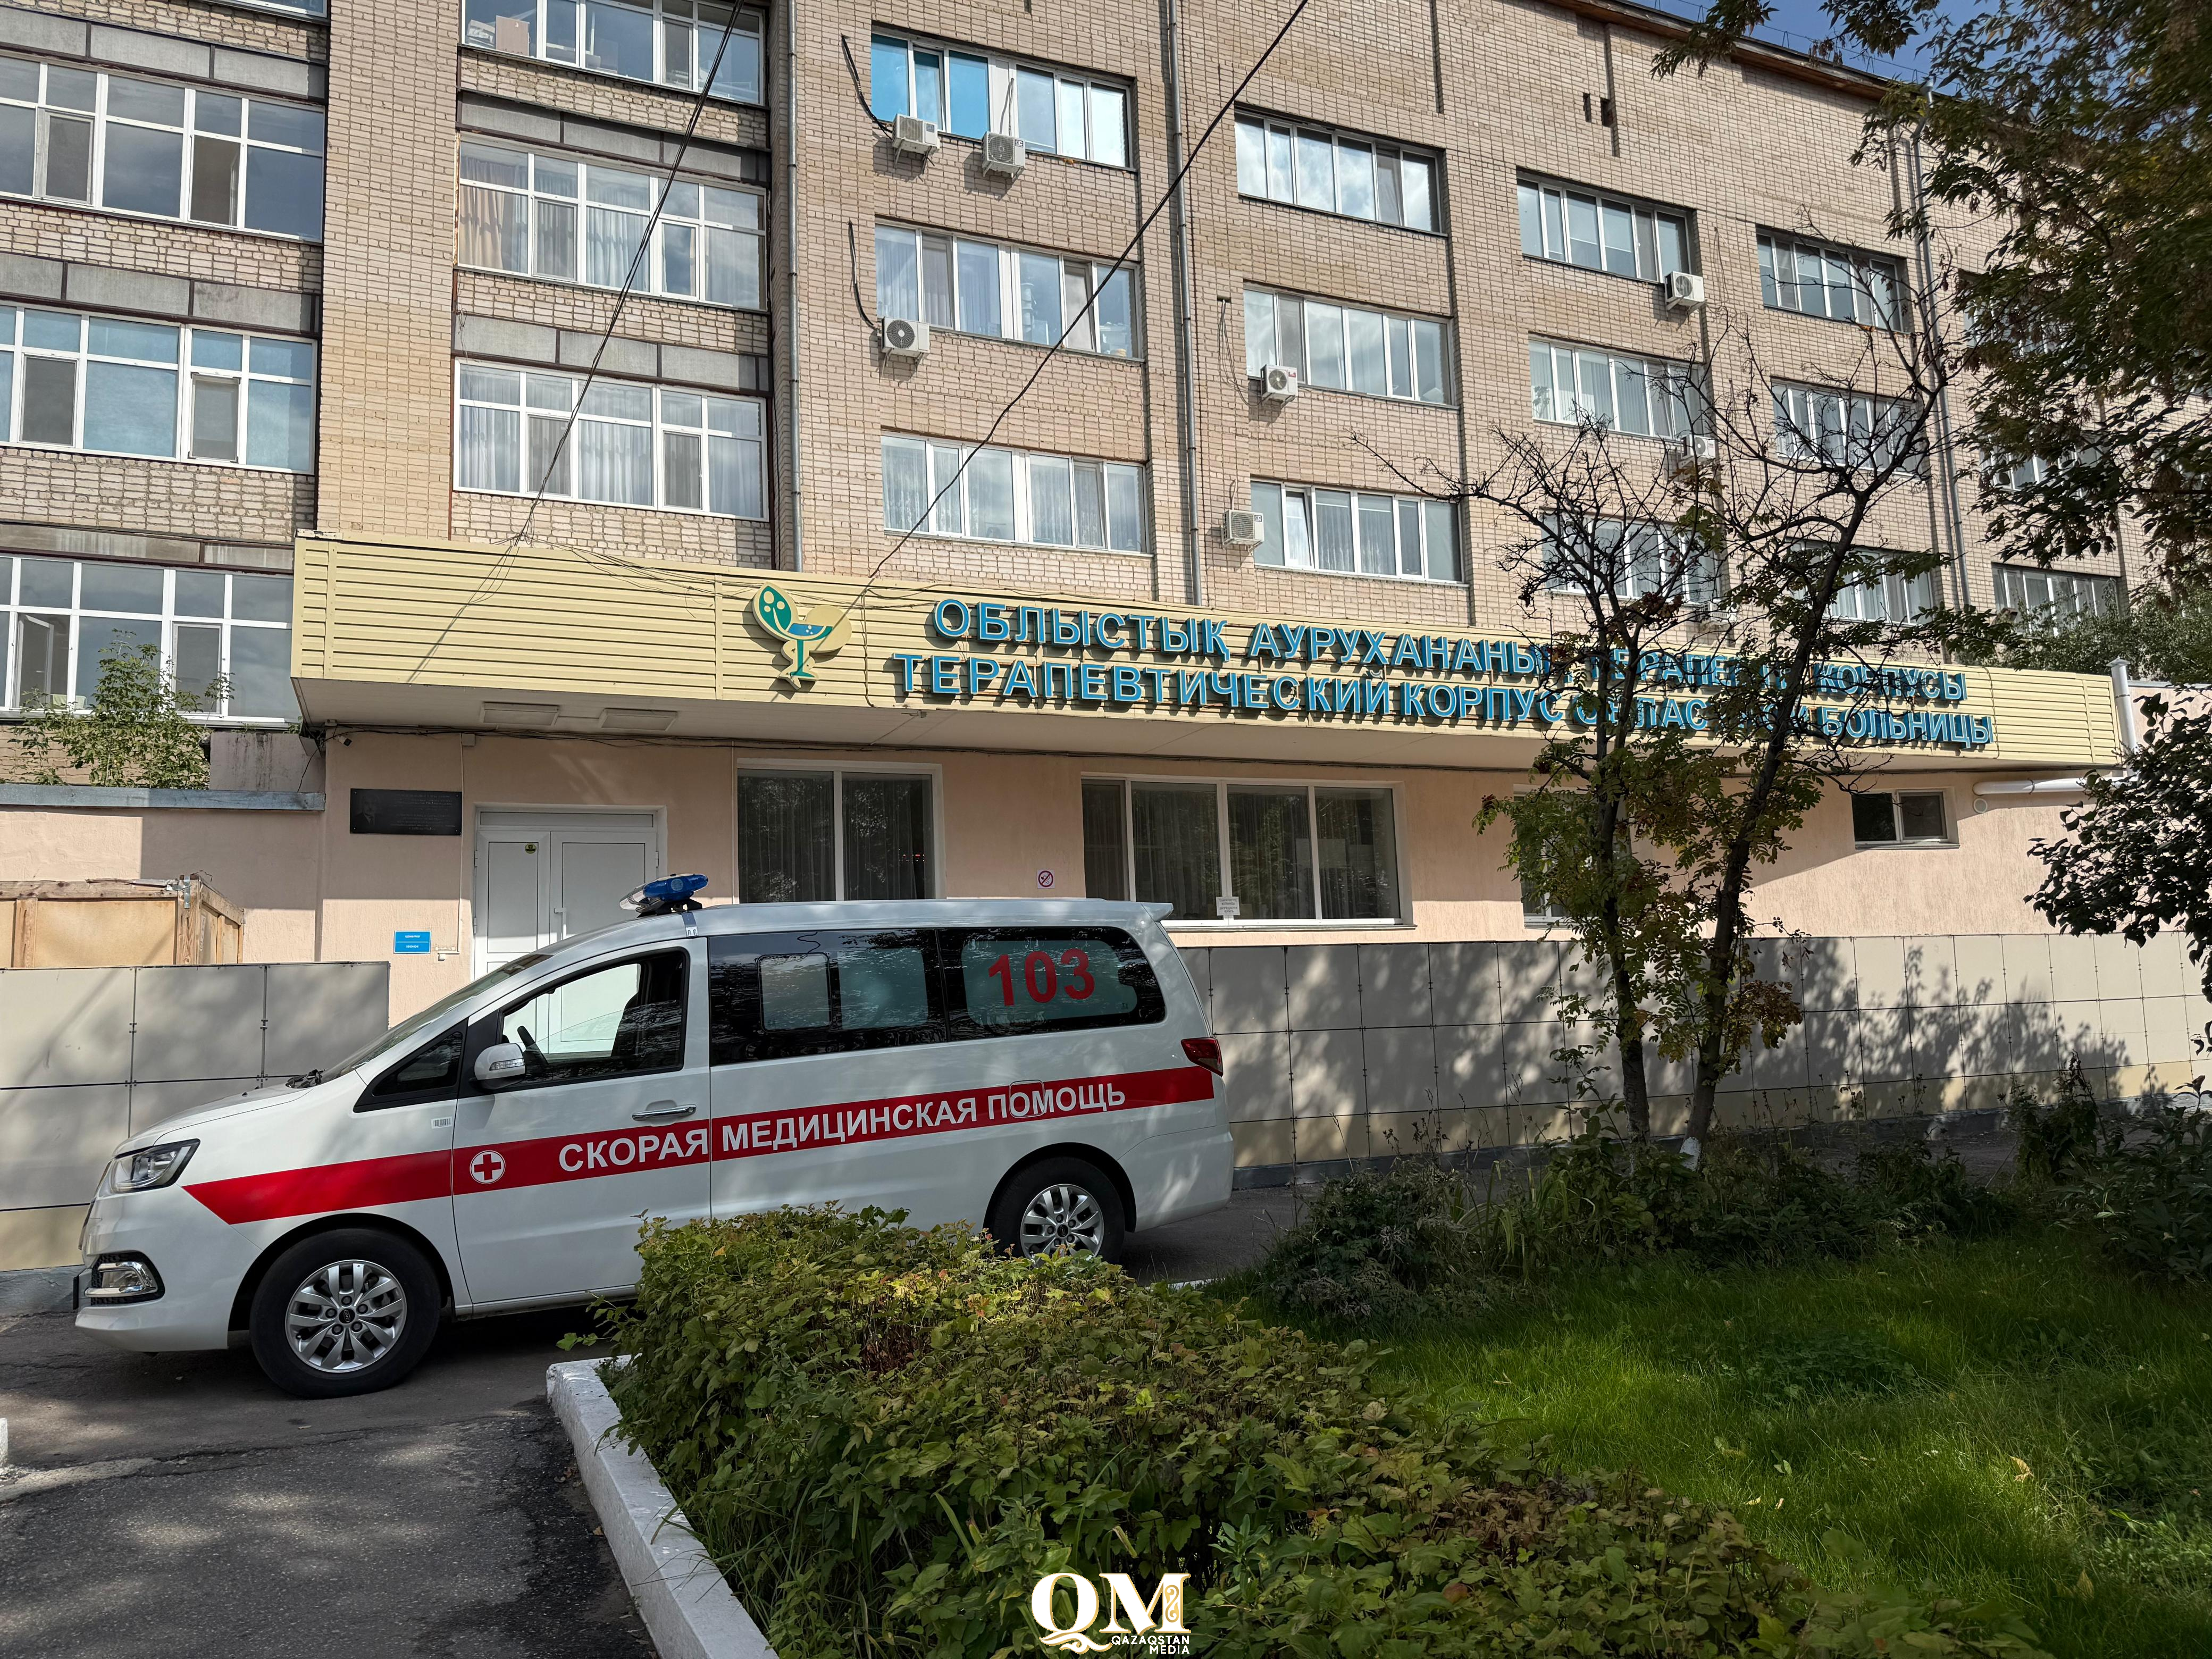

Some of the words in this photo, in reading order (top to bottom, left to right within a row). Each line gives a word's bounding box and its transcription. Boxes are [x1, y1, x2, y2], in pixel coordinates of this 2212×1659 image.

[933, 599, 1228, 662] ОБЛЫСТЫҚ
[1247, 622, 1574, 683] АУРУХАНАНЫ
[1812, 663, 1967, 701] КОРПУСЫ
[891, 652, 1389, 715] ТЕРАПЕВТИЧЕСКИЙ
[1400, 681, 1563, 724] КОРПУС
[1816, 706, 1994, 749] БОЛЬНИЦЫ
[988, 948, 1095, 1006] 103
[559, 1128, 708, 1172] СКОРАЯ
[722, 1097, 977, 1152] МЕДИЦИНСКАЯ
[988, 1083, 1126, 1120] ПОМОЩЬ
